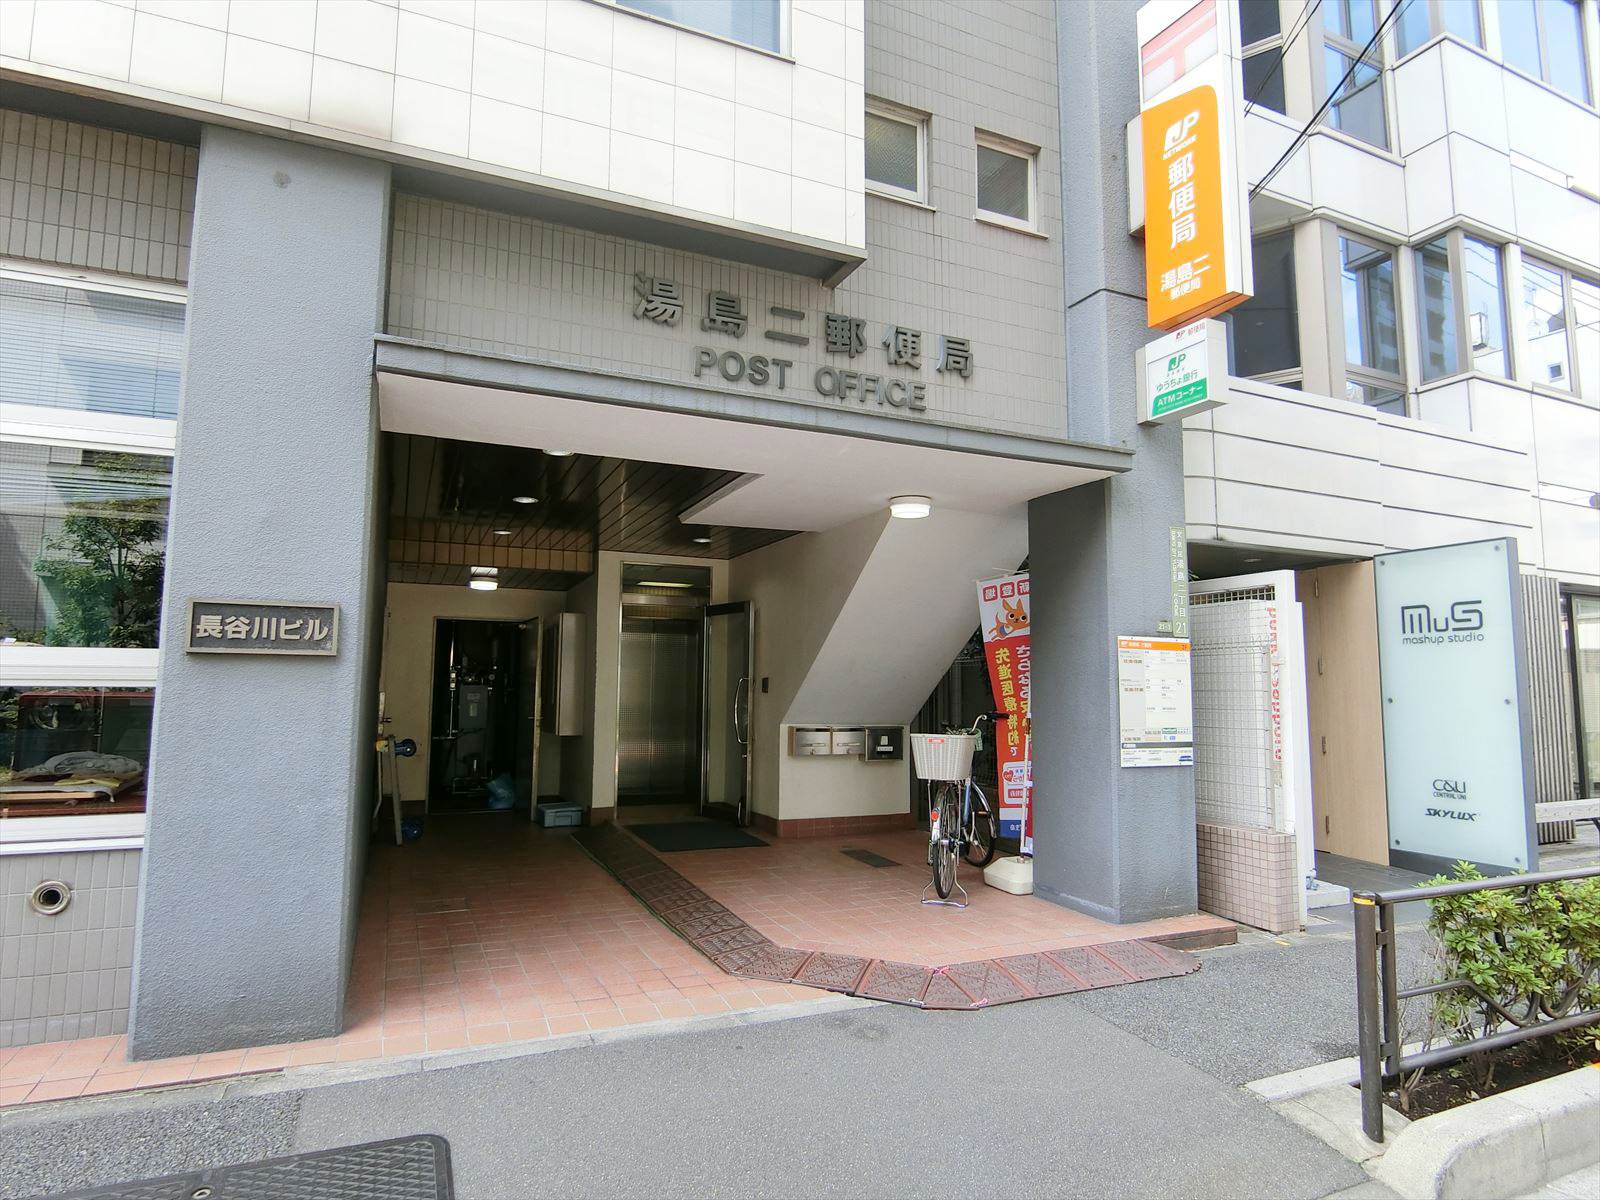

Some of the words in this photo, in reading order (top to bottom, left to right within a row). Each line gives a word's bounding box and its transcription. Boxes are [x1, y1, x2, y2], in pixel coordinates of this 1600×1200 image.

[1167, 151, 1197, 250] 郵便局
[1160, 254, 1211, 292] 湯島二
[1170, 277, 1201, 301] 郵便局
[633, 271, 975, 378] 湯島二郵便局
[694, 345, 793, 389] POST
[814, 365, 927, 411] OFFICE
[1156, 368, 1198, 393] ゆうちょ銀行
[1157, 385, 1203, 406] ATMコーナー
[196, 614, 329, 641] 長谷川ビル
[1175, 622, 1187, 633] 21
[1402, 634, 1445, 645] mashup
[1447, 632, 1485, 643] studio
[1425, 808, 1477, 822] SKYLUX
